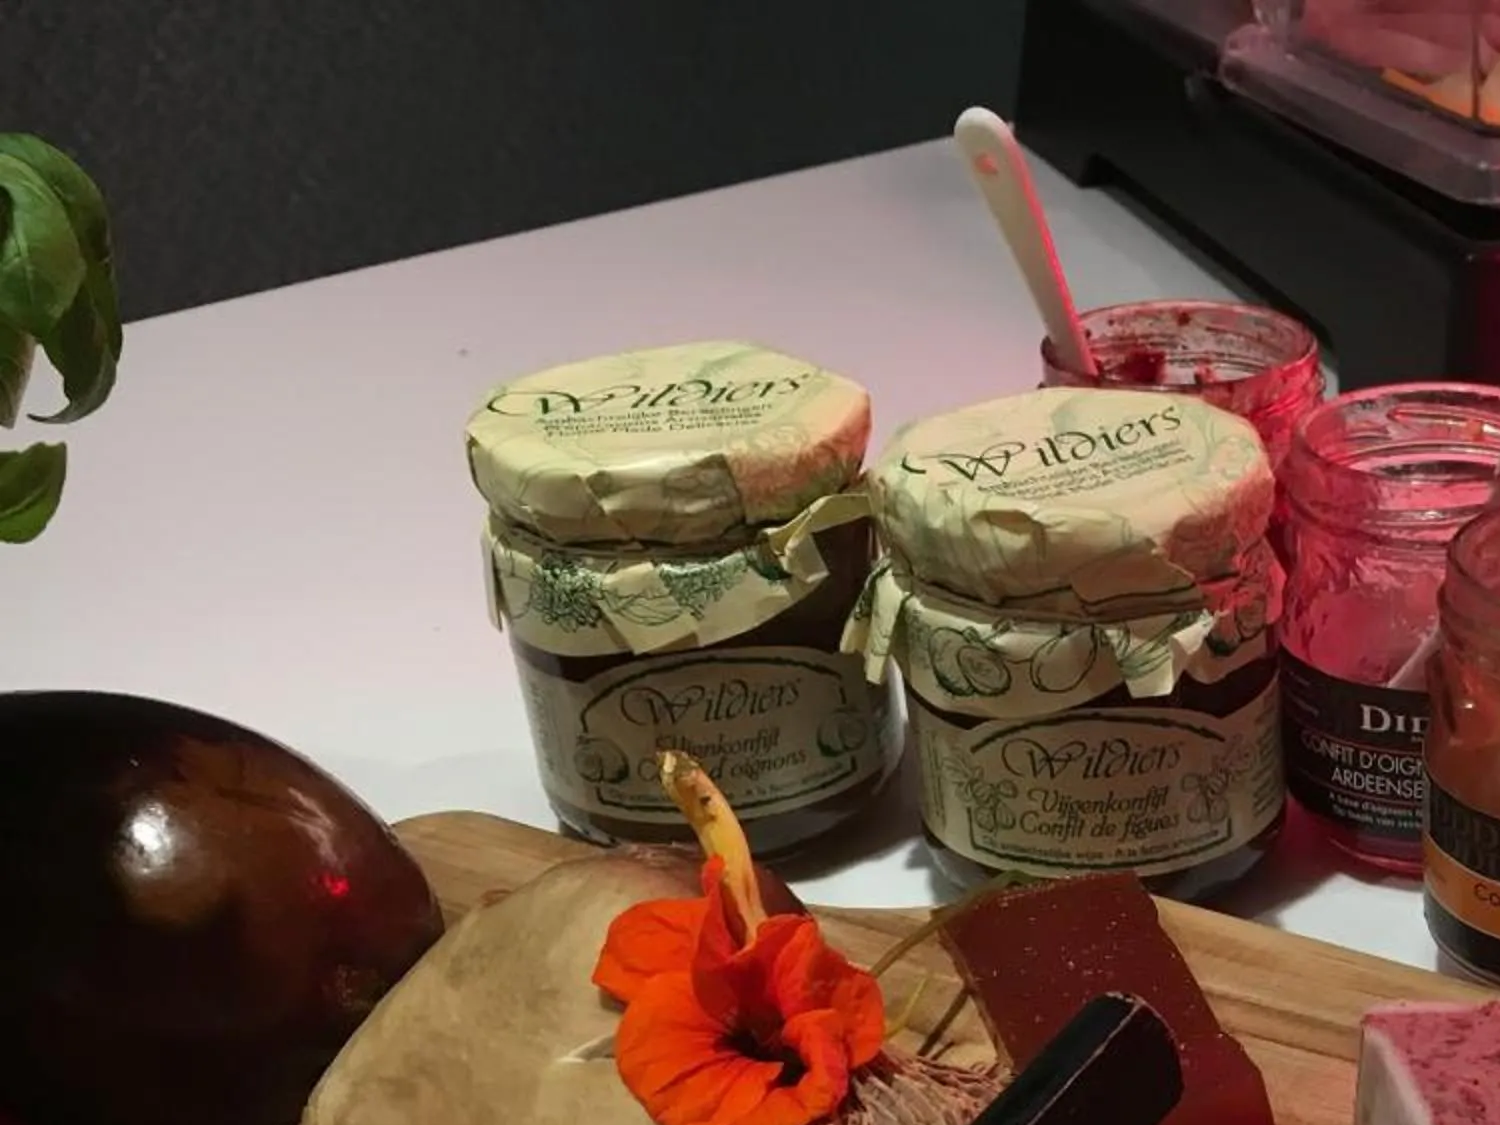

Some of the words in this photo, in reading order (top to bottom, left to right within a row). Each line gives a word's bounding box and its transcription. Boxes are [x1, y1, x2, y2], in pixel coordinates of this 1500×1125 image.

[487, 373, 809, 415] Wildiers
[901, 406, 1182, 482] Wildiers
[621, 678, 802, 727] Wildiers
[1002, 737, 1184, 779] Wildiers
[1028, 785, 1169, 818] Vijgenkonfijt
[1331, 767, 1424, 800] ARDEENSE
[1019, 810, 1082, 843] Confit
[1090, 812, 1116, 838] de
[1122, 812, 1180, 841] figues
